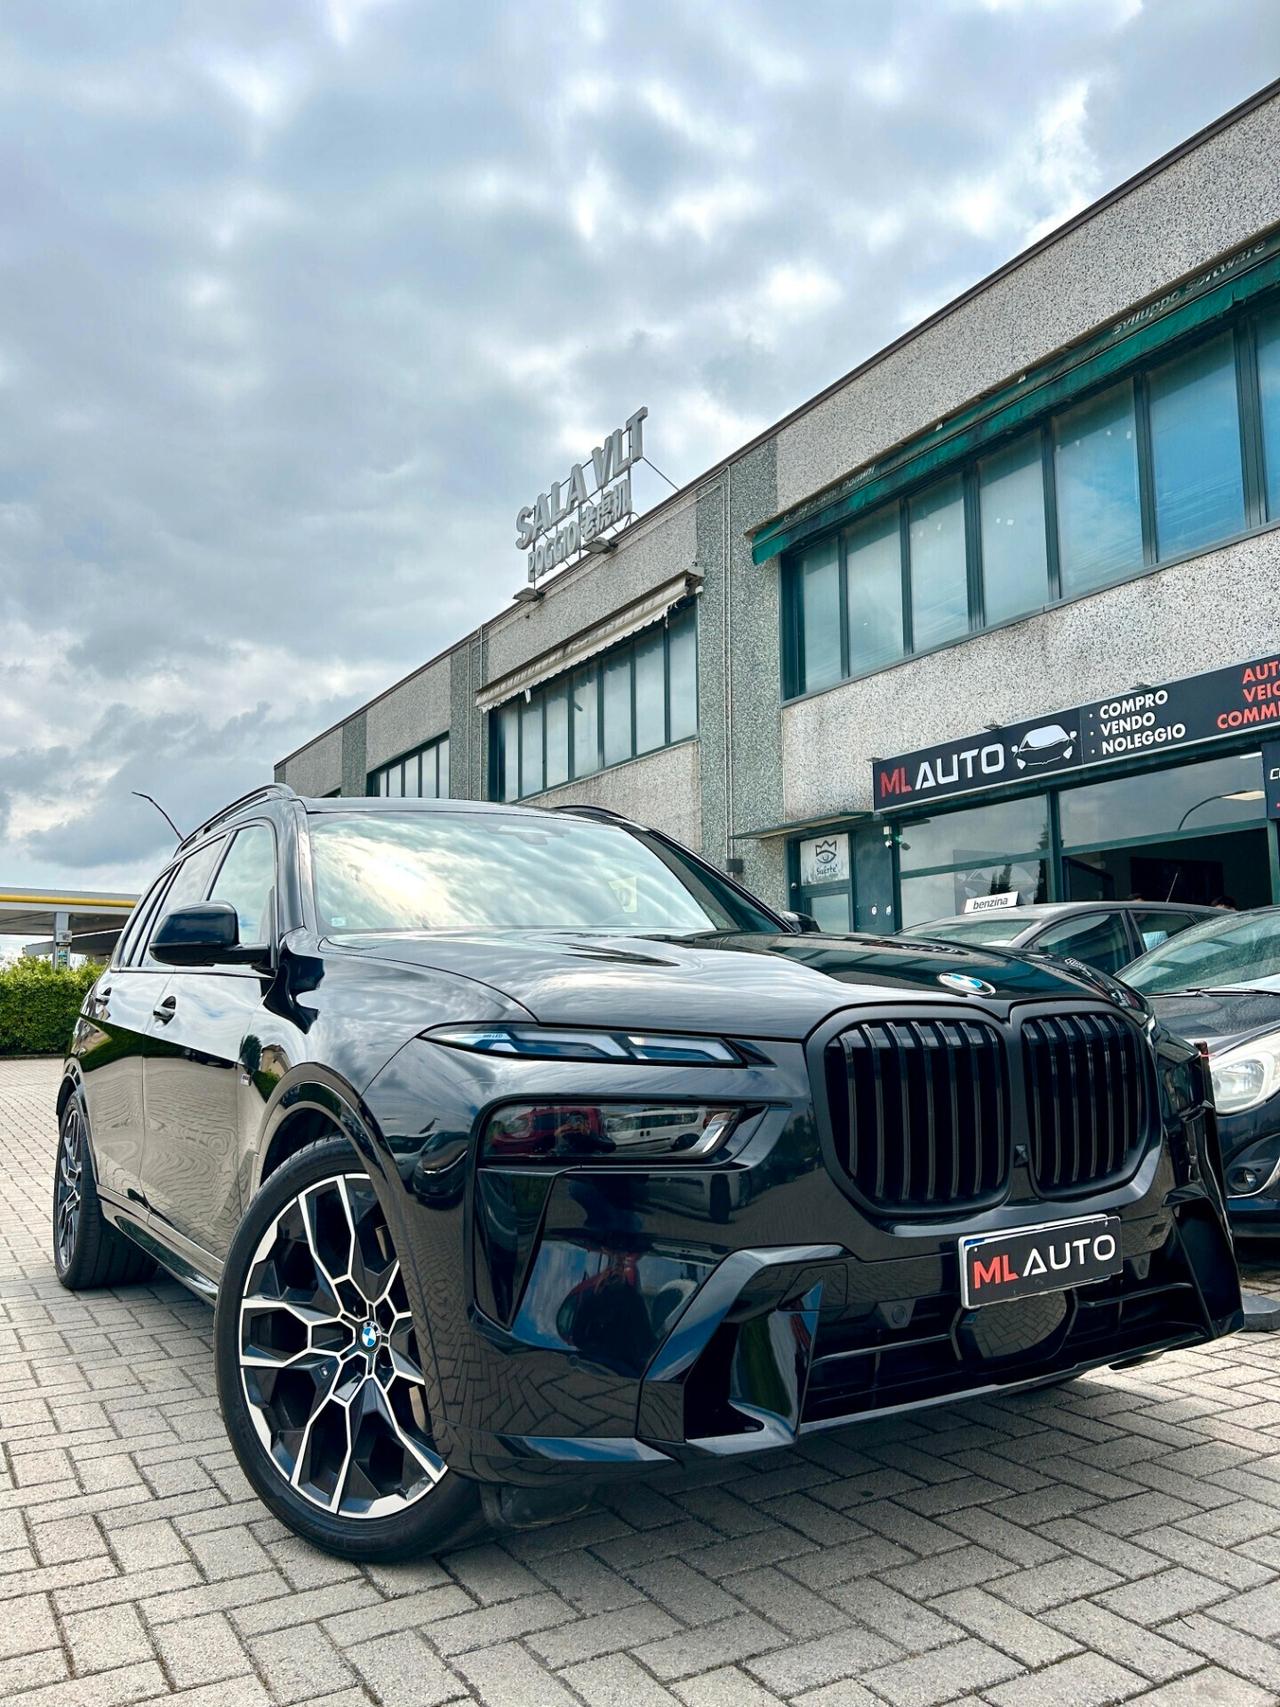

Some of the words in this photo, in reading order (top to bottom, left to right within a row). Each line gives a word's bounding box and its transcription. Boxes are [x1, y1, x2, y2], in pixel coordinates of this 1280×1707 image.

[1112, 290, 1181, 335] Sviluppo
[515, 463, 588, 550] SALA
[591, 406, 648, 490] VLT
[528, 520, 581, 583] POGGIO
[1242, 660, 1280, 684] AUT
[1100, 690, 1168, 719] COMPRO
[1217, 700, 1280, 729] COMM
[1101, 712, 1155, 737] VENDO
[1102, 723, 1186, 755] NOLEGGIO
[880, 767, 912, 797] ML
[915, 743, 1004, 791] AUTO
[973, 897, 1009, 910] benzina
[974, 1254, 1019, 1289] ML
[1023, 1234, 1116, 1277] AUTO
